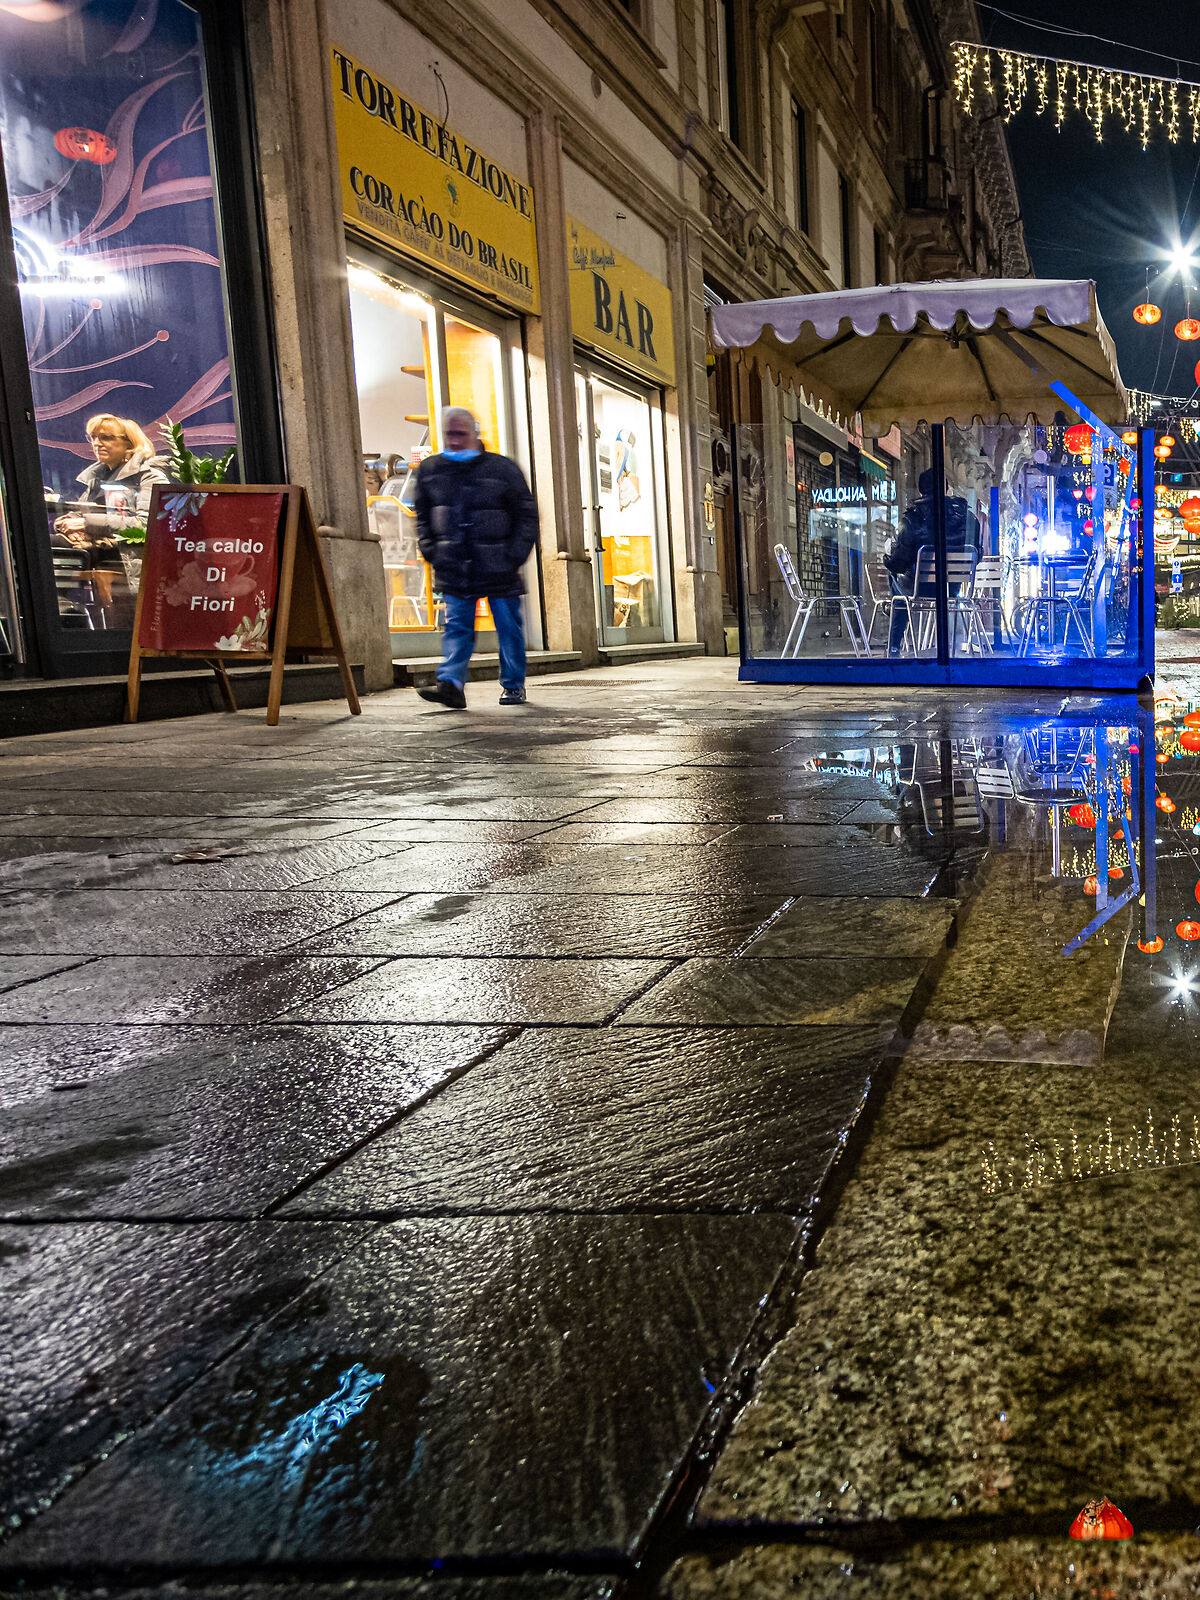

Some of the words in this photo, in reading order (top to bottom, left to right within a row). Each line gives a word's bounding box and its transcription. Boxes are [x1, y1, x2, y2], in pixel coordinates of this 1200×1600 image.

[333, 49, 532, 223] TORREFAZIONE
[356, 200, 402, 236] VENDITA
[449, 220, 475, 259] DO
[478, 238, 534, 292] BRASIL
[590, 268, 658, 363] BAR
[174, 537, 206, 553] Tea
[212, 538, 264, 554] caldo
[206, 566, 227, 582] Di
[190, 596, 235, 612] Fiori
